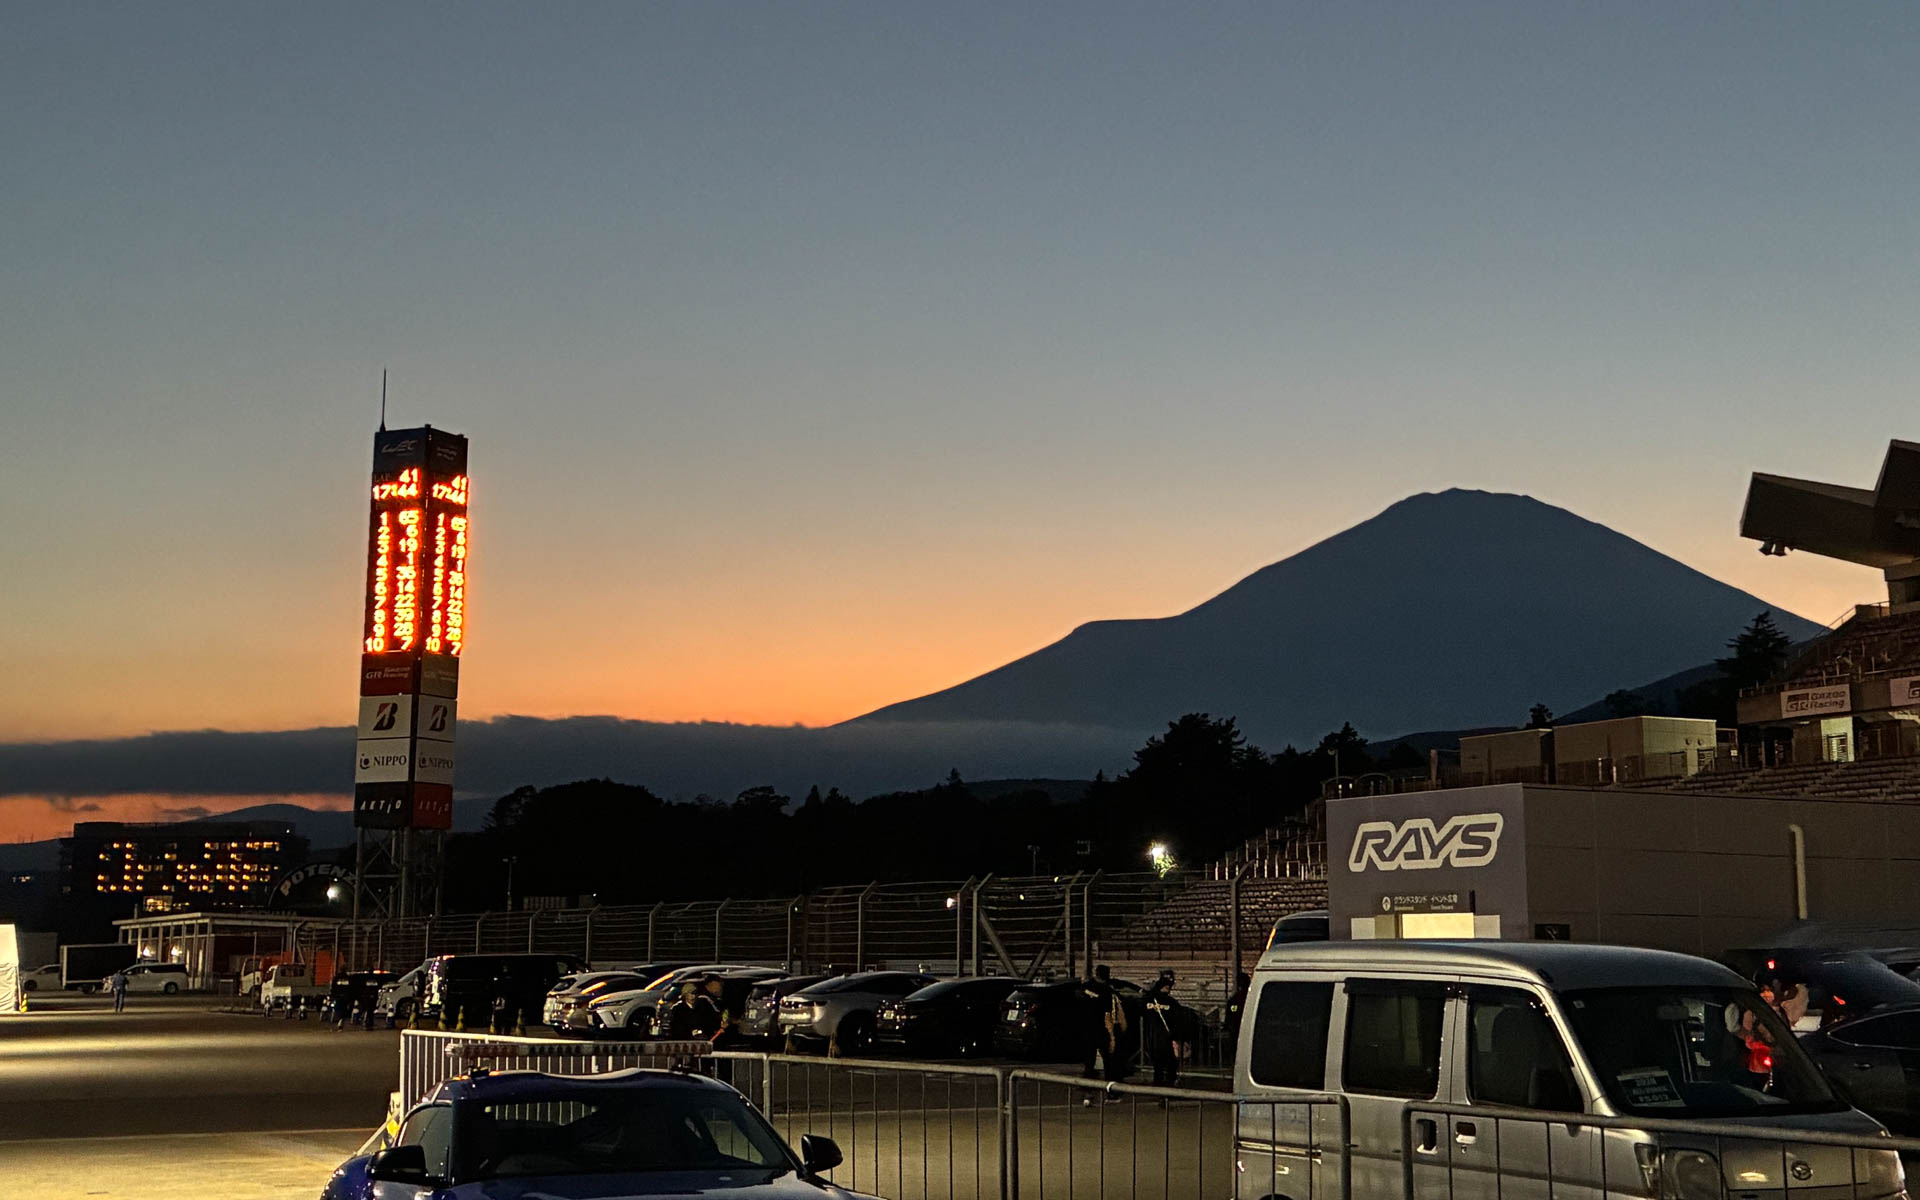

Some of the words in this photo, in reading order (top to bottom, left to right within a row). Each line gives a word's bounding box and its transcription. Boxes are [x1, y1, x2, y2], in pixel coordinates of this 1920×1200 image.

[399, 468, 418, 483] 41
[452, 475, 467, 491] 41
[372, 483, 418, 499] 17:44
[380, 512, 387, 526] 1
[438, 512, 444, 526] 1
[378, 526, 390, 539] 2
[406, 525, 418, 537] 6
[435, 527, 445, 540] 2
[457, 531, 465, 545] 6
[377, 540, 389, 553] 3
[399, 538, 418, 552] 19
[435, 540, 445, 554] 3
[451, 544, 466, 559] 19
[376, 554, 388, 567] 4
[406, 552, 413, 565] 1
[434, 555, 443, 567] 4
[457, 559, 463, 572] 1
[376, 567, 387, 581] 5
[433, 567, 443, 581] 5
[375, 581, 386, 595] 6
[397, 580, 415, 593] 14
[433, 582, 442, 595] 6
[449, 585, 463, 599] 14
[374, 595, 386, 609] 7
[394, 593, 415, 608] 22
[432, 596, 443, 609] 7
[446, 599, 463, 613] 22
[374, 609, 385, 623] 8
[394, 608, 414, 622] 39
[432, 609, 441, 623] 8
[373, 623, 384, 637] 9
[393, 621, 414, 636] 28
[432, 623, 441, 637] 9
[365, 637, 384, 652] 10
[401, 635, 413, 650] 7
[426, 636, 440, 652] 10
[450, 641, 461, 655] 7
[1787, 701, 1809, 712] GR
[1810, 699, 1845, 709] Racing
[373, 755, 407, 767] NIPPO
[428, 757, 453, 769] NIPPO
[1348, 812, 1504, 872] RAYS
[280, 864, 358, 897] POTENZ
